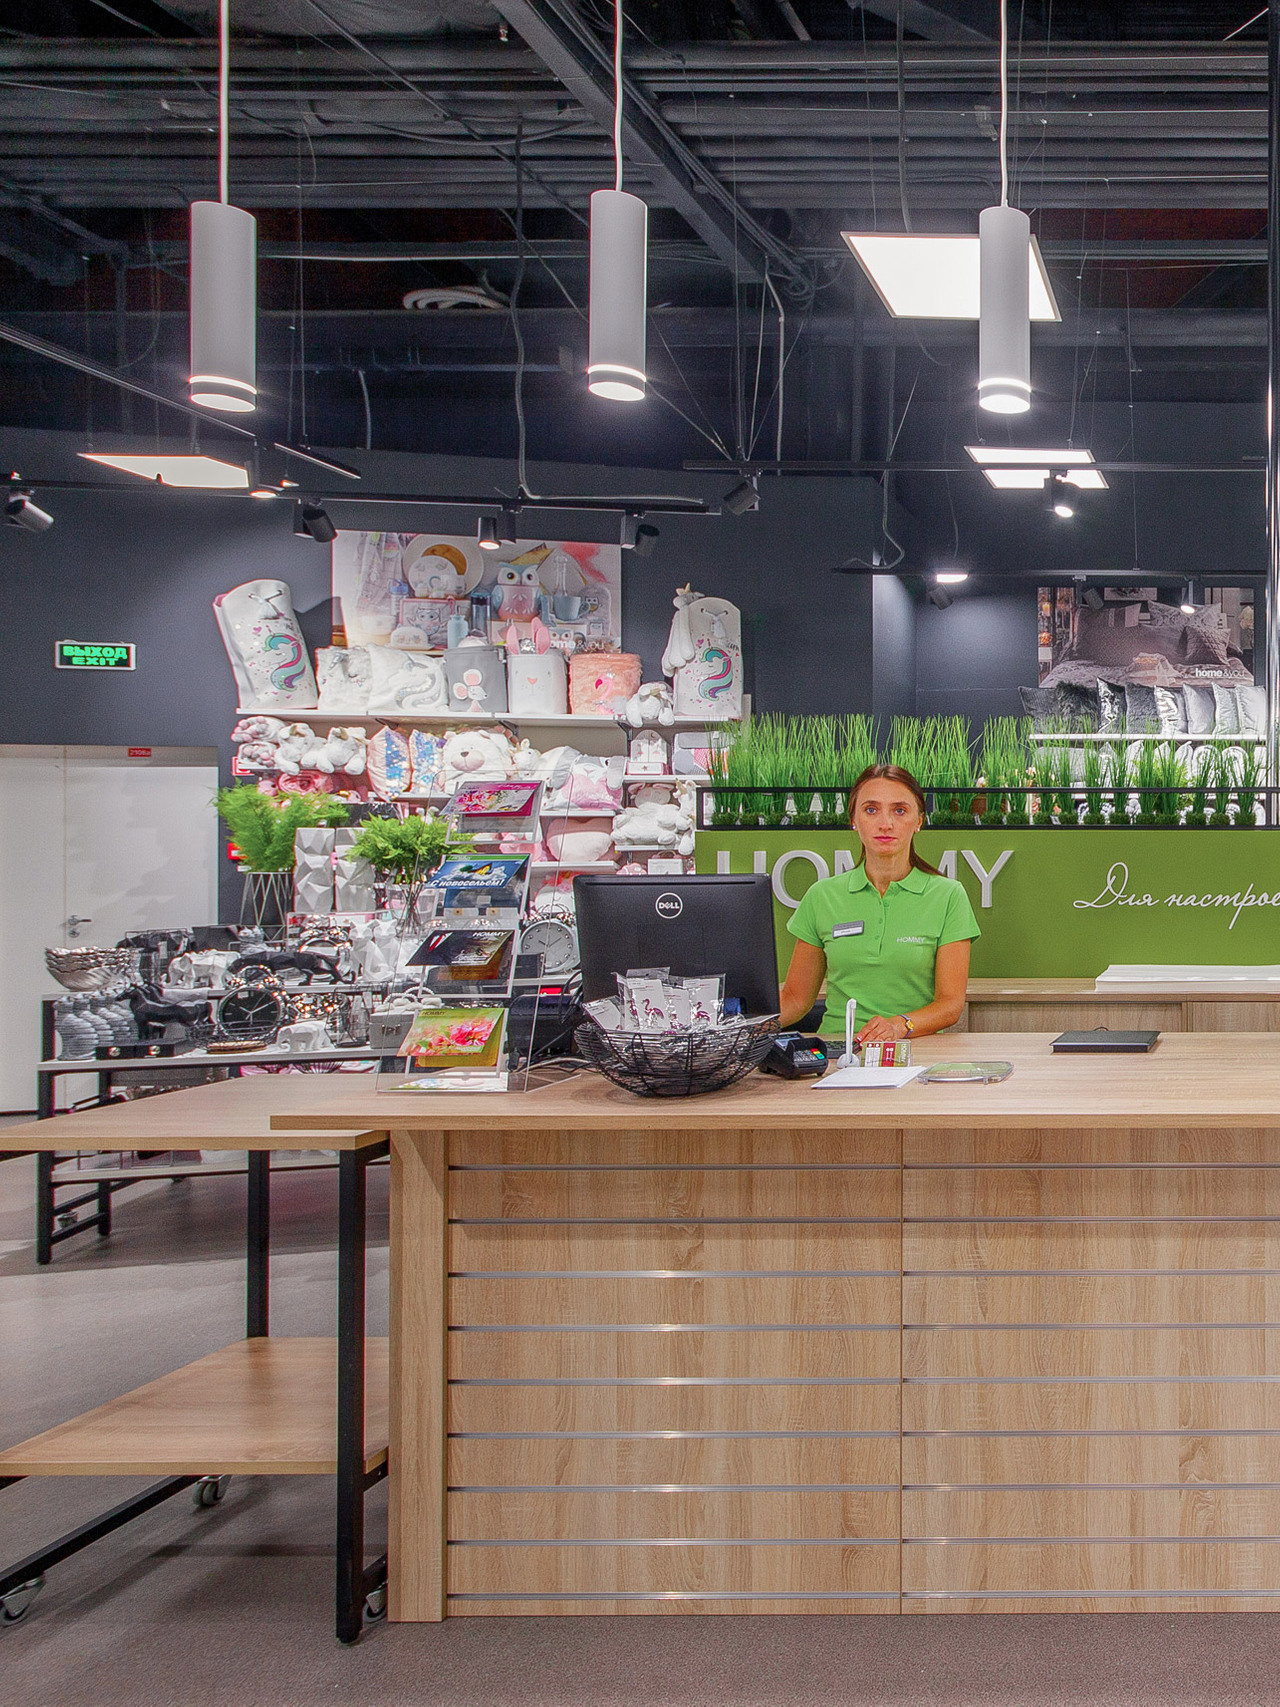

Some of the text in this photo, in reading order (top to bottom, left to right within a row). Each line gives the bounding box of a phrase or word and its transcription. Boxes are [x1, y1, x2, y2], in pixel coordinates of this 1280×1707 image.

[62, 645, 128, 660] ВЫХОД
[71, 656, 119, 666] EXIT
[1195, 667, 1246, 679] home&you
[439, 878, 505, 887] новосельем!
[1072, 862, 1160, 909] Для
[658, 901, 681, 910] DELL
